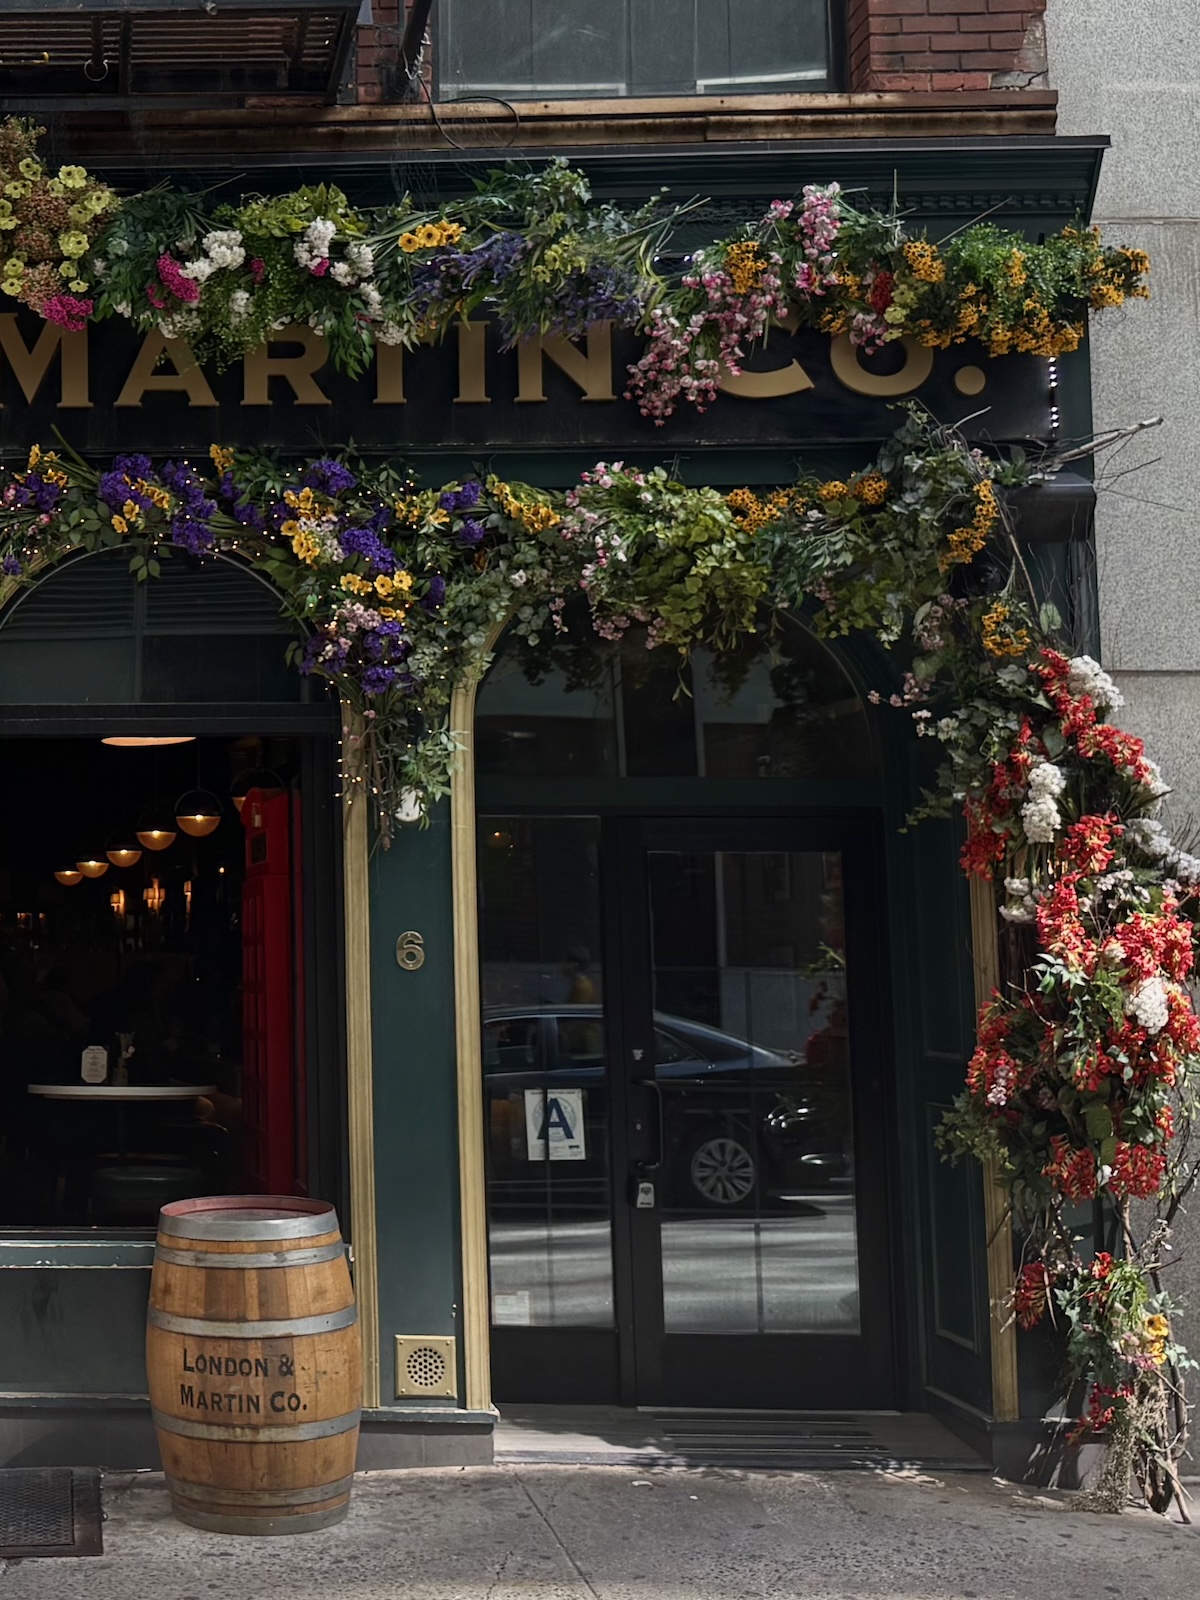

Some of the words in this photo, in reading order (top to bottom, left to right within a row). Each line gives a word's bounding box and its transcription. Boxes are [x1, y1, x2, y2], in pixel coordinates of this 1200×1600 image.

[395, 930, 425, 971] 6
[536, 1097, 575, 1140] A
[183, 1348, 269, 1378] LONDON
[278, 1353, 295, 1377] &
[180, 1383, 261, 1414] MARTIN
